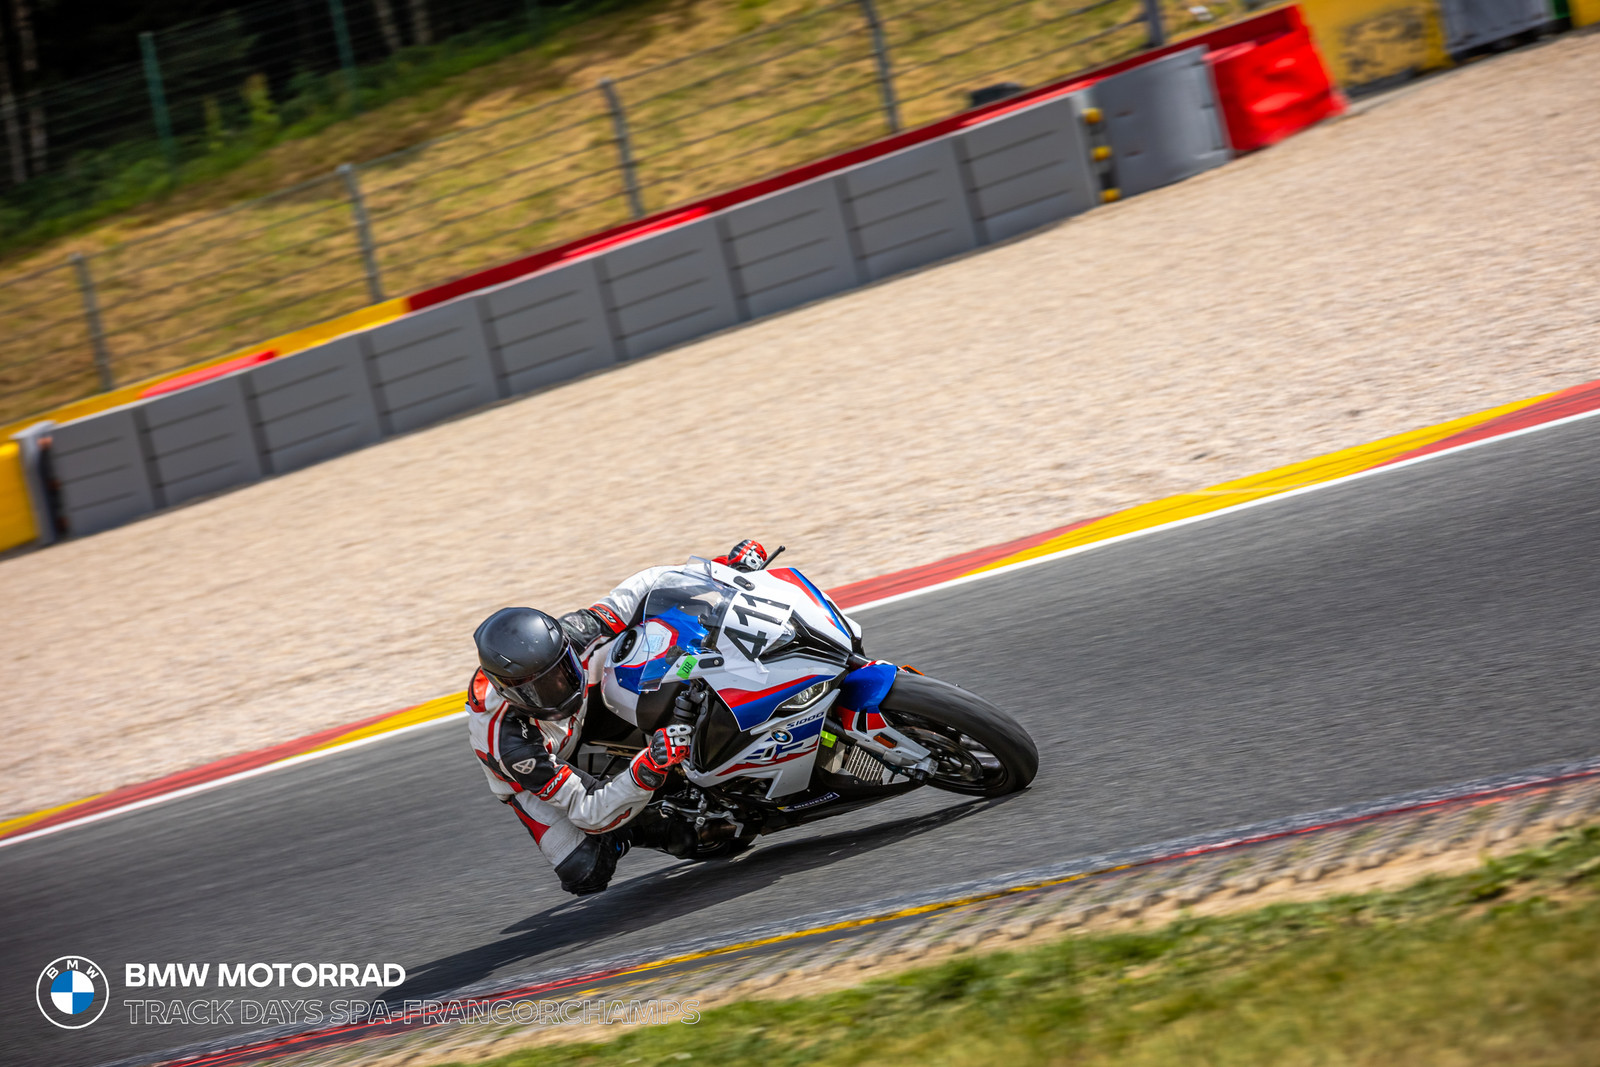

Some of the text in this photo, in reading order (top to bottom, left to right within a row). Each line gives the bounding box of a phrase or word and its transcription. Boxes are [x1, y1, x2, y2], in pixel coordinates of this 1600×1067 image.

[724, 593, 791, 662] 411
[785, 711, 825, 730] S1000
[793, 793, 834, 810] MICHELIN
